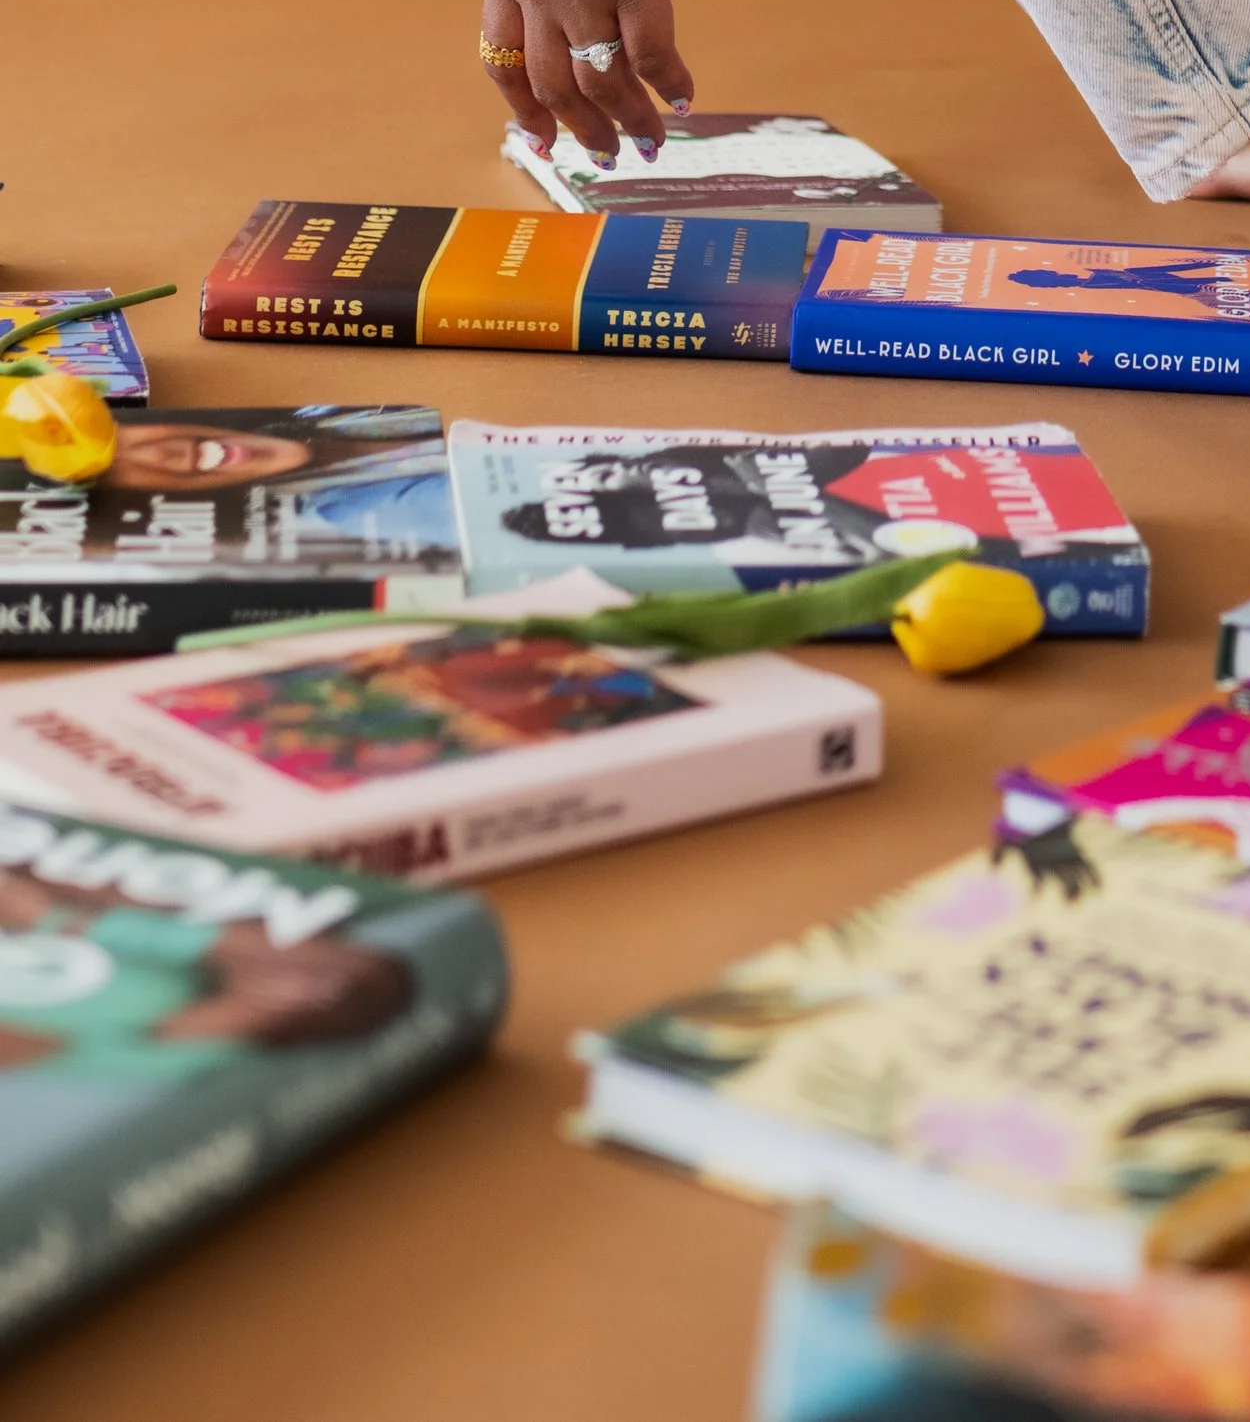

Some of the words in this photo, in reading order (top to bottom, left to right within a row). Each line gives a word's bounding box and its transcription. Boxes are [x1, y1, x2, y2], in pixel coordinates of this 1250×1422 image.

[303, 217, 336, 233] IS
[657, 218, 685, 251] HERSEY
[283, 234, 325, 262] REST
[332, 206, 398, 278] RESISTANCE
[500, 217, 540, 268] MANIFESTO
[934, 240, 975, 266] GIRL
[496, 269, 519, 278] A
[647, 253, 676, 290] TRICIA
[866, 238, 918, 297] WELL-READ
[925, 266, 968, 303] BLACK
[256, 296, 321, 315] REST
[334, 299, 364, 317] IS
[1215, 282, 1250, 319] GLORY
[223, 318, 395, 339] RESISTANCE
[438, 317, 449, 328] A
[457, 318, 560, 332] MANIFESTO
[607, 309, 706, 329] TRICIA
[604, 333, 707, 351] HERSEY
[815, 338, 931, 359] WELL-READ
[939, 343, 1005, 363] BLACK
[1012, 348, 1061, 366] GIRL
[1114, 352, 1185, 372] GLORY
[1191, 356, 1240, 374] EDIM
[482, 433, 540, 445] THE
[557, 434, 626, 446] NEW
[651, 466, 718, 531] DAYS
[754, 452, 825, 516] JUNE
[967, 445, 1067, 557] WILLIAMS
[114, 493, 216, 562] Hair
[60, 592, 149, 635] Hair
